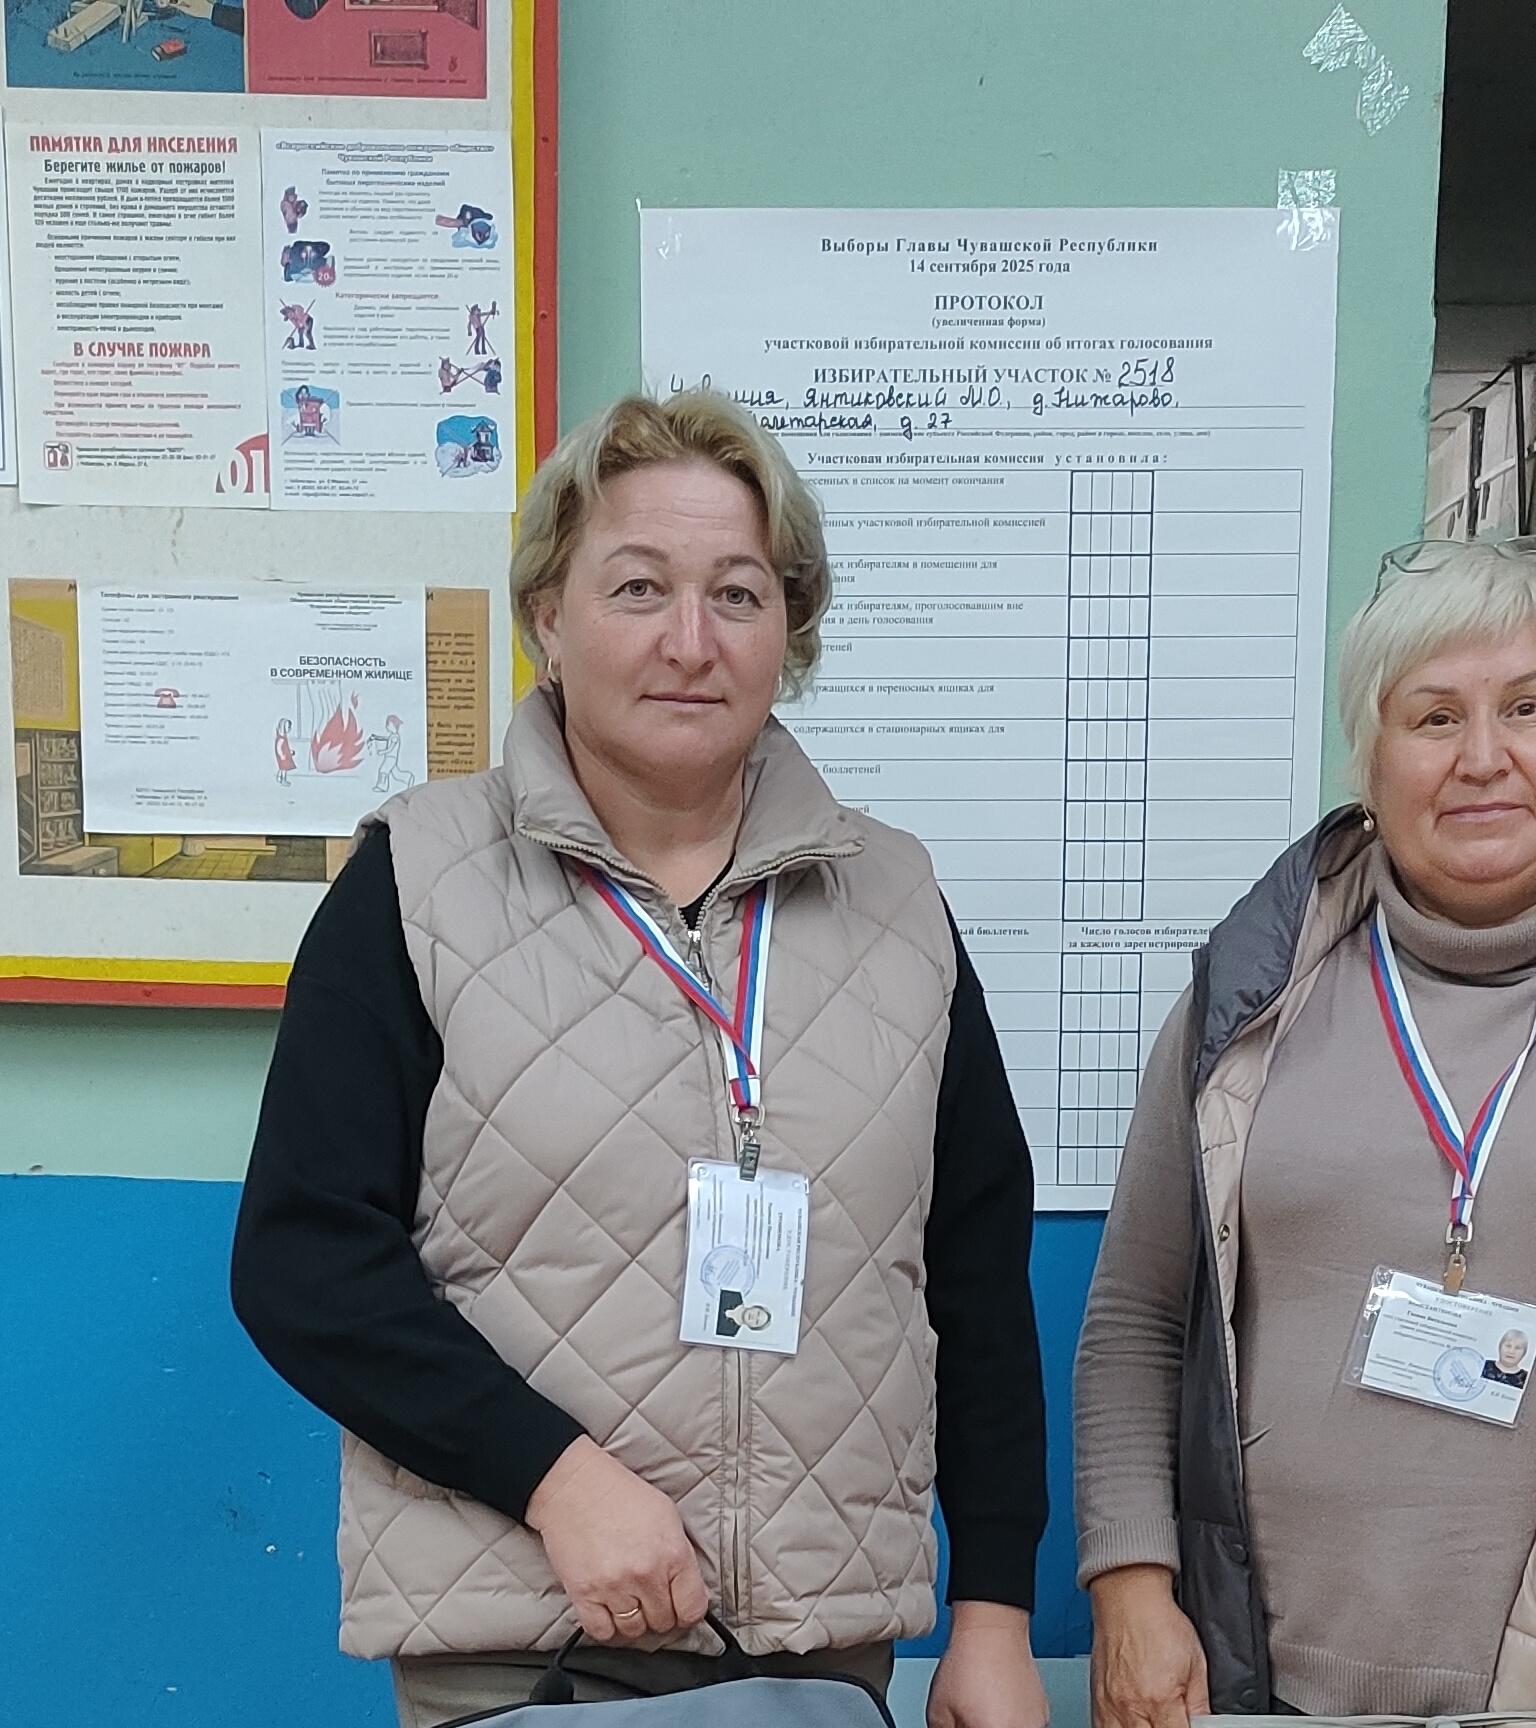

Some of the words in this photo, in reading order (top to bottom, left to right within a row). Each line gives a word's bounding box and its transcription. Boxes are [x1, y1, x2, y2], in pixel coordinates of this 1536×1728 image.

[30, 136, 103, 153] ПАМЯТКА
[108, 136, 142, 154] ДЛЯ
[148, 136, 238, 153] НАСЕЛЕНИЯ
[44, 159, 101, 175] Берегите
[106, 161, 146, 173] жилье
[151, 162, 165, 173] от
[169, 160, 226, 176] пожаров!
[821, 238, 889, 256] Выборы
[896, 238, 950, 253] Главы
[957, 238, 1052, 256] Чувашской
[1059, 238, 1158, 255] Республики
[910, 259, 925, 273] 14
[930, 259, 997, 277] сентября
[1001, 260, 1034, 273] 2025
[1038, 262, 1071, 274] года
[934, 295, 1043, 311] ПРОТОКОЛ
[931, 316, 1004, 329] (увеличенная
[1007, 316, 1046, 329] форма)
[74, 342, 84, 357] В
[88, 342, 145, 358] СЛУЧАЕ
[150, 342, 211, 358] ПОЖАРА
[764, 336, 849, 353] участковой
[854, 336, 965, 353] избирательной
[969, 340, 1041, 350] комиссии
[1045, 336, 1062, 350] об
[1066, 339, 1115, 350] итогах
[1120, 338, 1213, 350] голосования
[814, 364, 988, 384] ИЗБИРАТЕЛЬНЫЙ
[993, 368, 1089, 384] УЧАСТОК
[1092, 369, 1111, 383] №
[1118, 357, 1175, 388] 2518
[803, 385, 948, 410] Янтиковский
[928, 412, 952, 430] 27
[807, 452, 882, 466] Участковая
[886, 452, 981, 467] избирательная
[984, 454, 1045, 465] комиссия
[852, 478, 858, 486] в
[861, 478, 894, 487] список
[898, 478, 909, 486] на
[912, 478, 949, 486] момент
[952, 478, 1005, 486] окончания
[858, 517, 913, 530] участковой
[916, 517, 990, 530] избирательной
[993, 517, 1046, 528] комиссией
[846, 559, 909, 572] избирателям
[912, 561, 918, 569] в
[920, 561, 978, 570] помещении
[981, 560, 998, 571] для
[846, 600, 912, 614] избирателям,
[915, 602, 1004, 613] проголосовавшим
[1008, 602, 1024, 611] вне
[838, 616, 844, 624] в
[846, 616, 870, 626] день
[872, 616, 934, 625] голосования
[299, 656, 387, 668] БЕЗОПАСНОСТЬ
[270, 668, 277, 678] В
[280, 668, 363, 680] СОВРЕМЕННОМ
[364, 670, 413, 681] ЖИЛИЩЕ
[868, 684, 874, 692] в
[876, 684, 936, 695] переносных
[940, 684, 975, 694] ящиках
[977, 684, 995, 694] для
[793, 724, 866, 736] содержащихся
[868, 725, 874, 734] в
[876, 724, 946, 736] стационарных
[948, 724, 985, 735] ящиках
[988, 724, 1005, 736] для
[822, 764, 882, 774] бюллетеней
[976, 926, 1030, 937] бюллетень
[1081, 926, 1112, 937] Число
[1114, 926, 1152, 936] голосов
[1068, 940, 1077, 949] за
